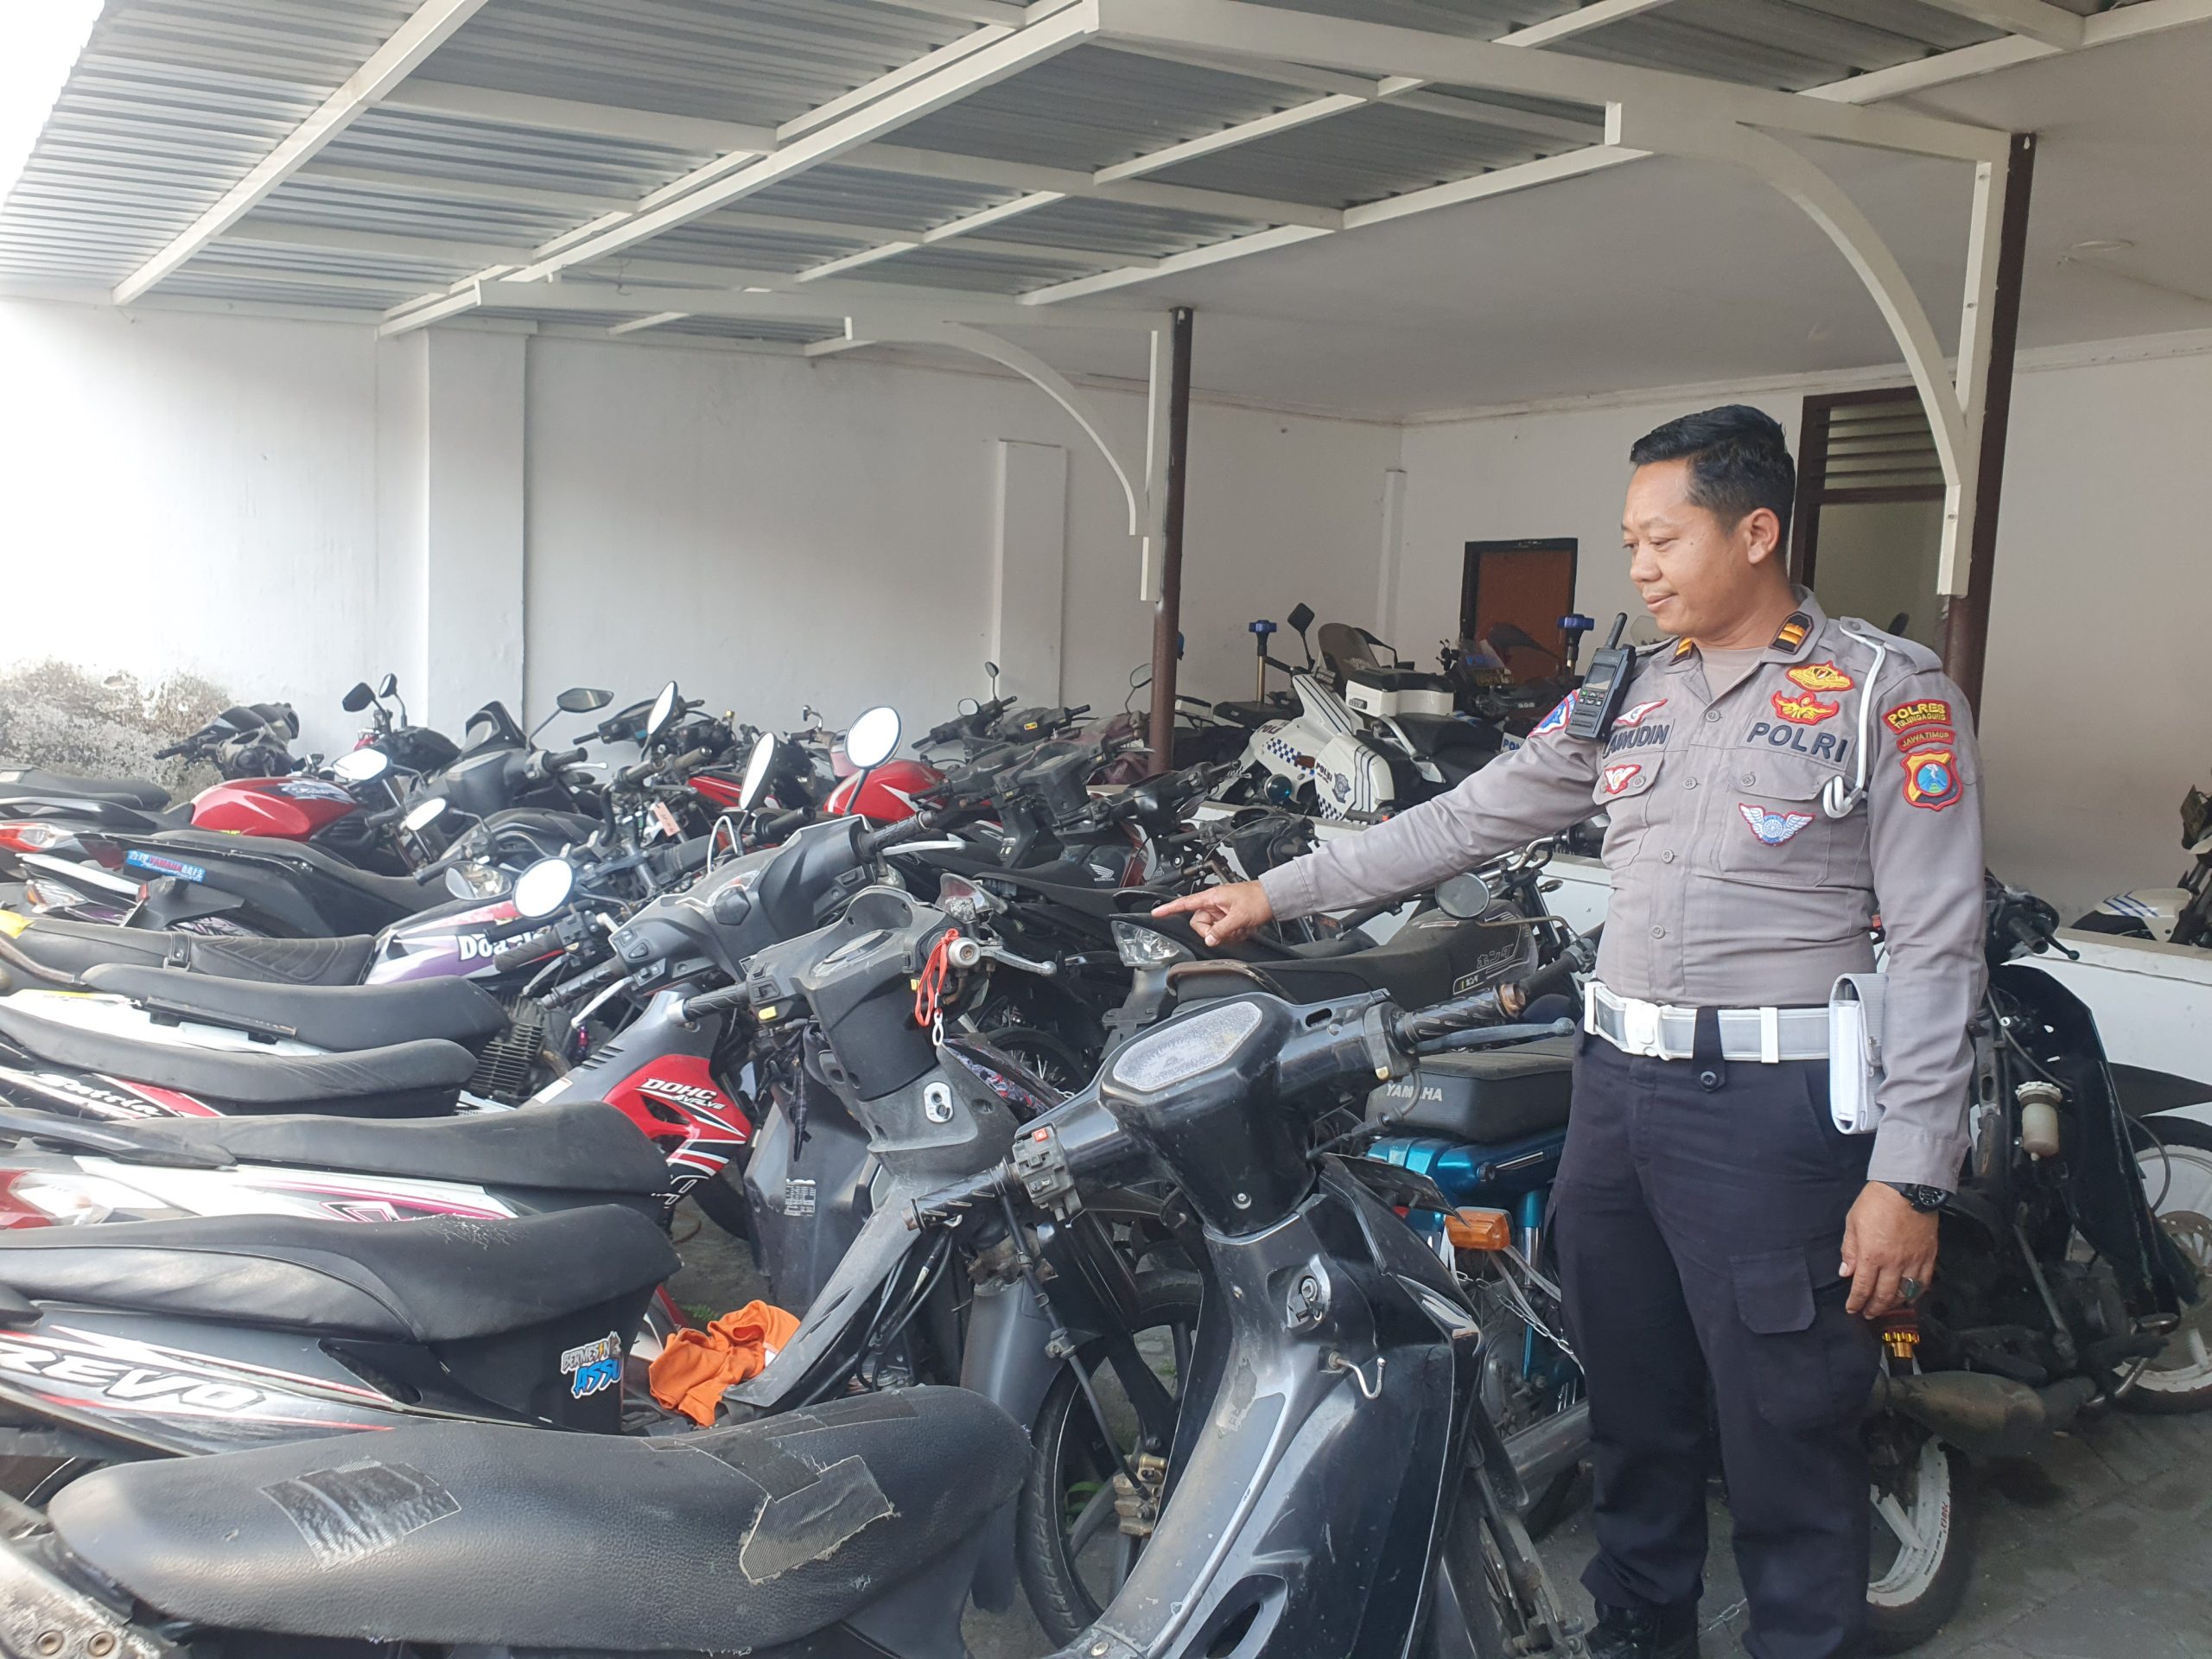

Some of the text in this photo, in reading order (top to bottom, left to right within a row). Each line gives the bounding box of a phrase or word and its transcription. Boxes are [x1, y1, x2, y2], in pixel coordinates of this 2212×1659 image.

[1888, 703, 1946, 724] POLRES
[1894, 714, 1946, 729] TULUNGAGUNG
[1746, 722, 1848, 762] POLRI
[1903, 734, 1923, 747] JAWA
[640, 1077, 718, 1100] DOHC
[1386, 1084, 1442, 1102] YAMHA
[0, 1339, 266, 1412] REVO
